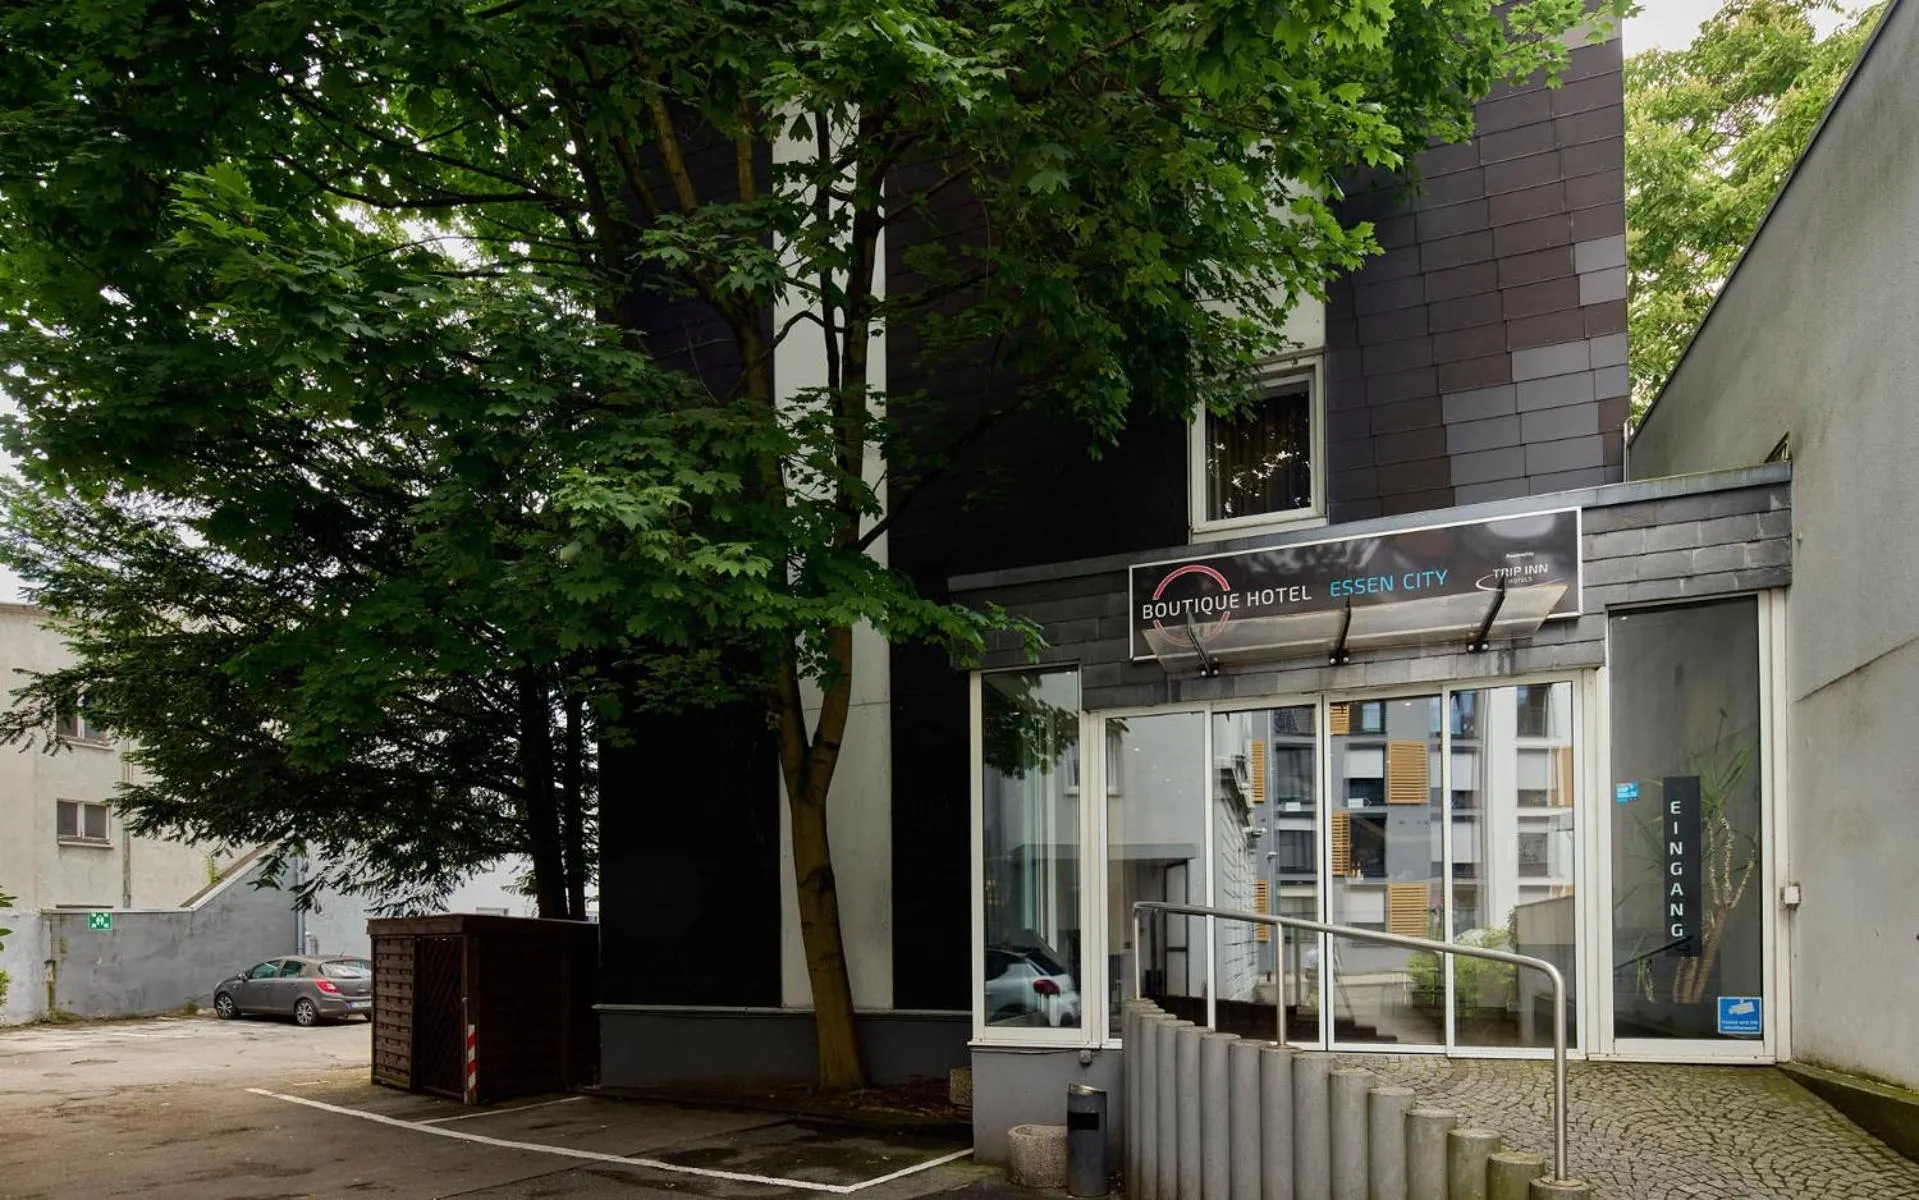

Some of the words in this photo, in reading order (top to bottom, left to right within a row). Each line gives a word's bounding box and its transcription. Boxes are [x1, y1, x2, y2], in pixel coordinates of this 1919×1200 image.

[1142, 593, 1240, 620] BOUTIQUE
[1246, 585, 1312, 607] HOTEL
[1330, 575, 1394, 597] ESSEN
[1402, 568, 1448, 590] CITY
[1493, 566, 1522, 578] TRIP
[1524, 563, 1549, 575] INN
[1669, 800, 1684, 937] EINGANG
